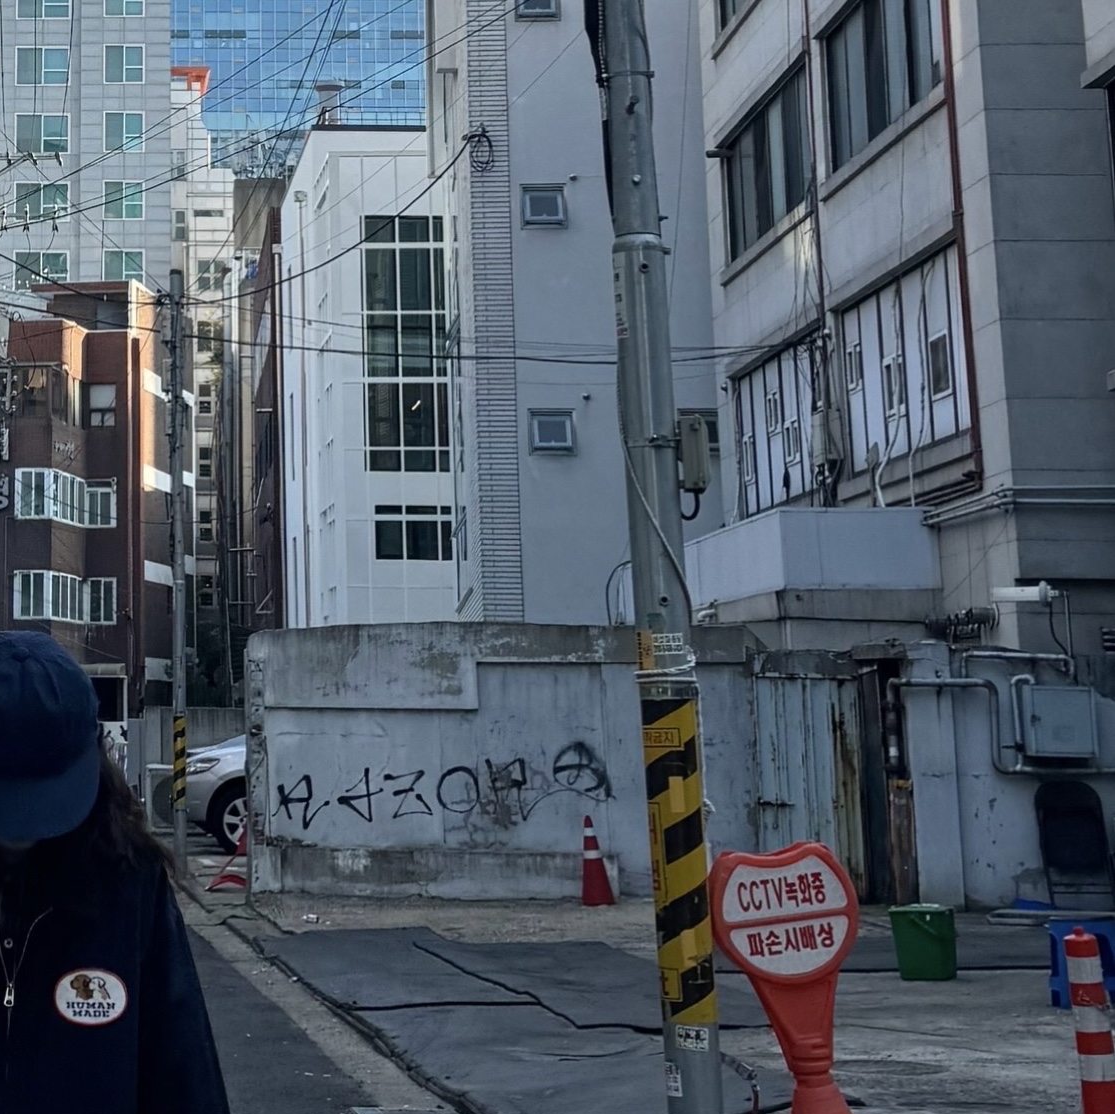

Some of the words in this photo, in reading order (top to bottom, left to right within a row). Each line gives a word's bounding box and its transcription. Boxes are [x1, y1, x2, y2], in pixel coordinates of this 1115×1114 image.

[737, 872, 826, 912] CCTV녹화중
[746, 922, 835, 958] 파손시배상
[66, 1001, 116, 1010] HUMAN
[72, 1010, 110, 1018] MADE
